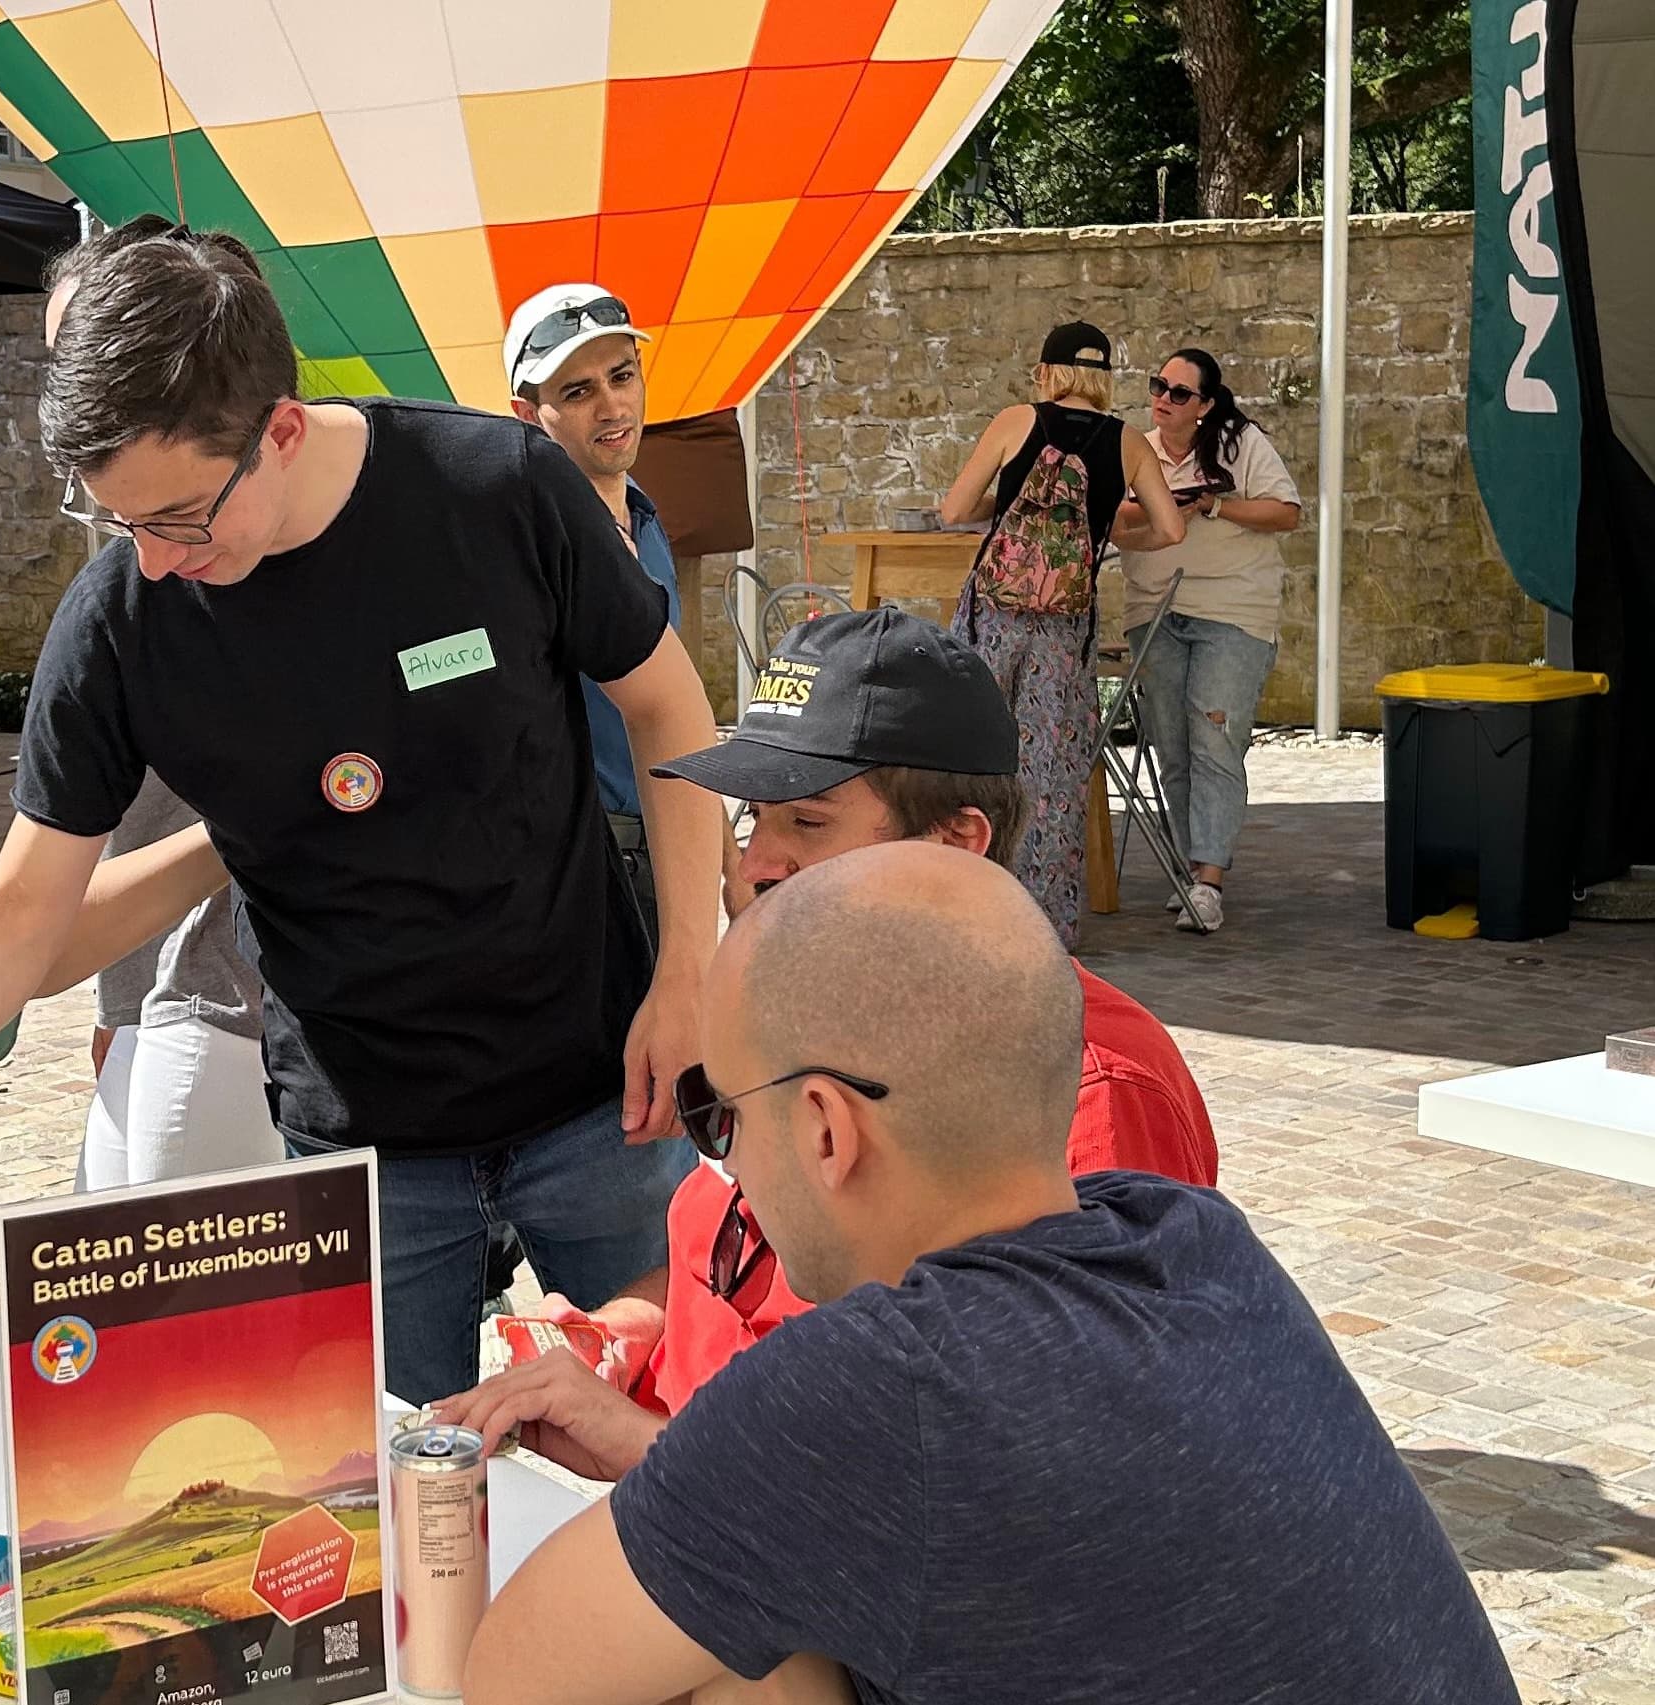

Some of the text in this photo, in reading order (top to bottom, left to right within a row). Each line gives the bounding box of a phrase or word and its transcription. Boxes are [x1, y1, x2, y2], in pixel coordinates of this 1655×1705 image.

[407, 646, 483, 677] Alvaro
[769, 656, 821, 677] Take your
[31, 1210, 287, 1271] Catan Settlers:
[32, 1229, 350, 1305] Battle of Luxembourg VII
[257, 1536, 343, 1582] Pre-registration
[266, 1551, 341, 1592] is required for
[281, 1568, 335, 1598] this event
[244, 1665, 292, 1685] 12 euro
[156, 1683, 216, 1705] Amazon,
